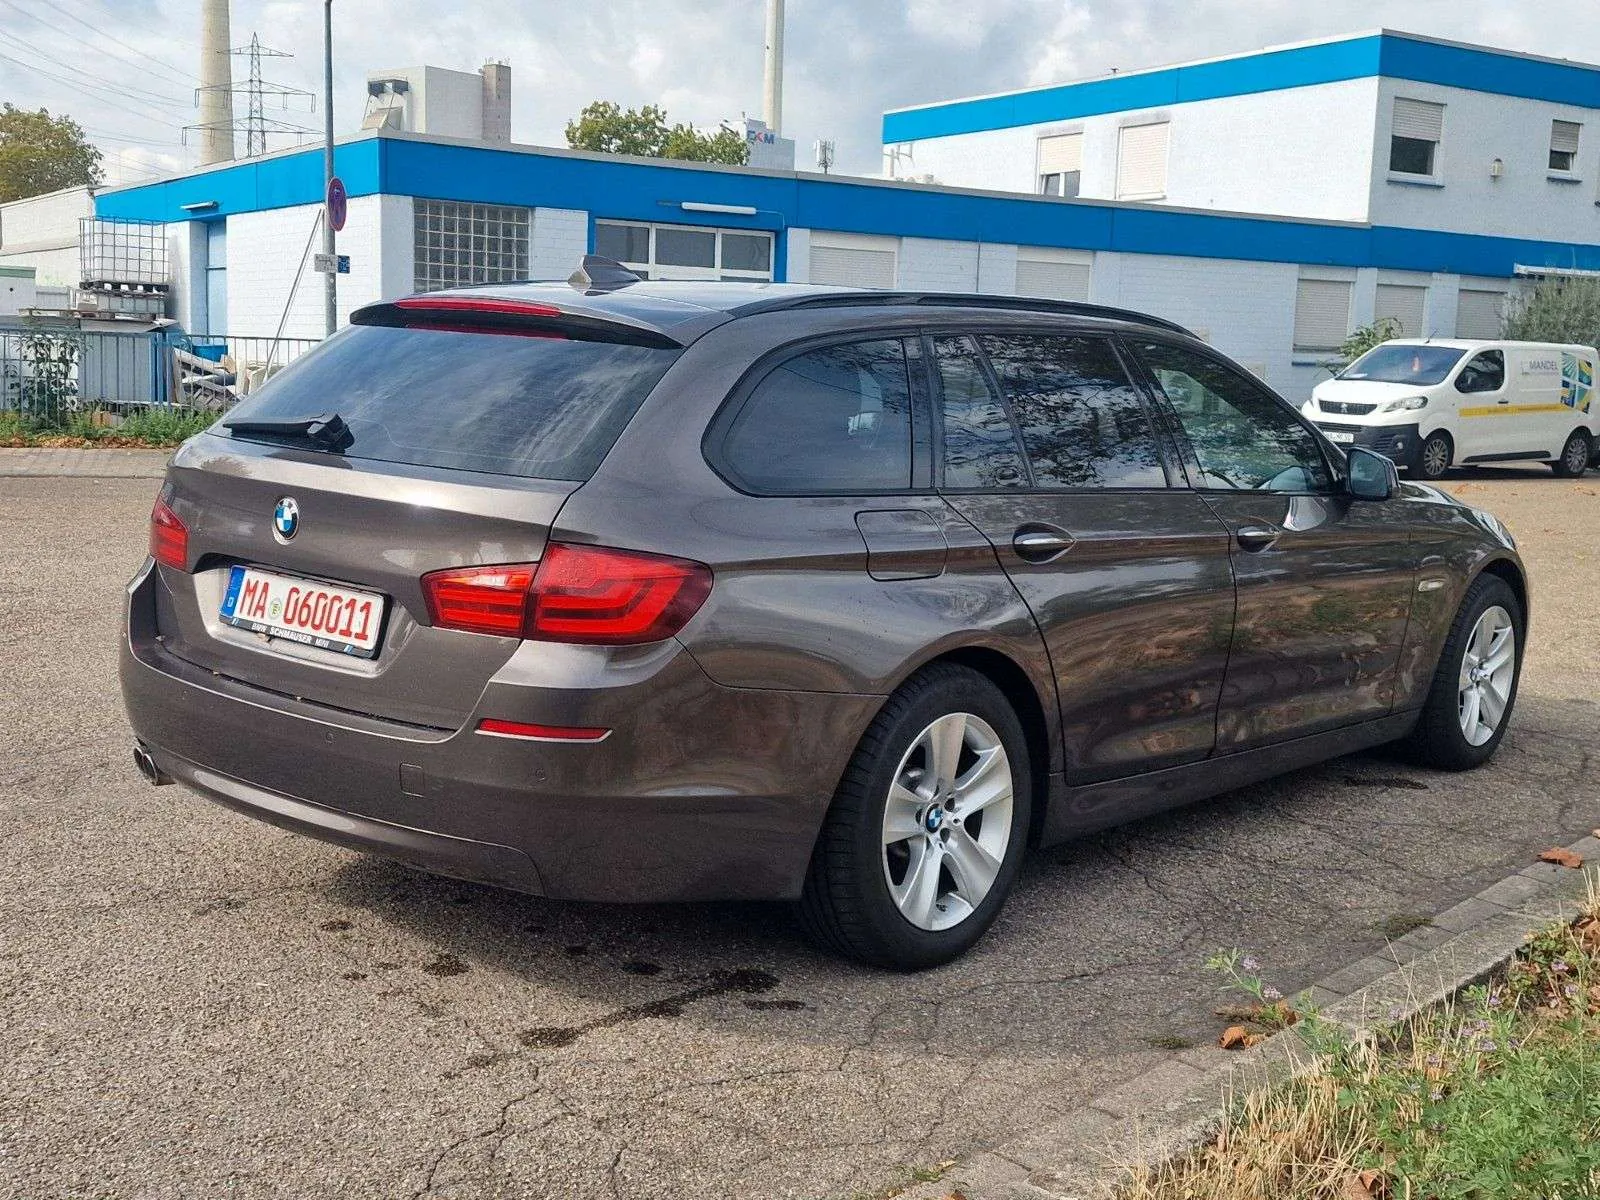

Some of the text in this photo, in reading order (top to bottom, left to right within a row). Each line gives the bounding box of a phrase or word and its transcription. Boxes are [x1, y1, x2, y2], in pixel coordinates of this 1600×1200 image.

[1529, 360, 1558, 370] MANDEL
[227, 597, 234, 608] D
[239, 578, 372, 641] MA 060011
[251, 622, 330, 648] BMW SCHMAUSER MINI
